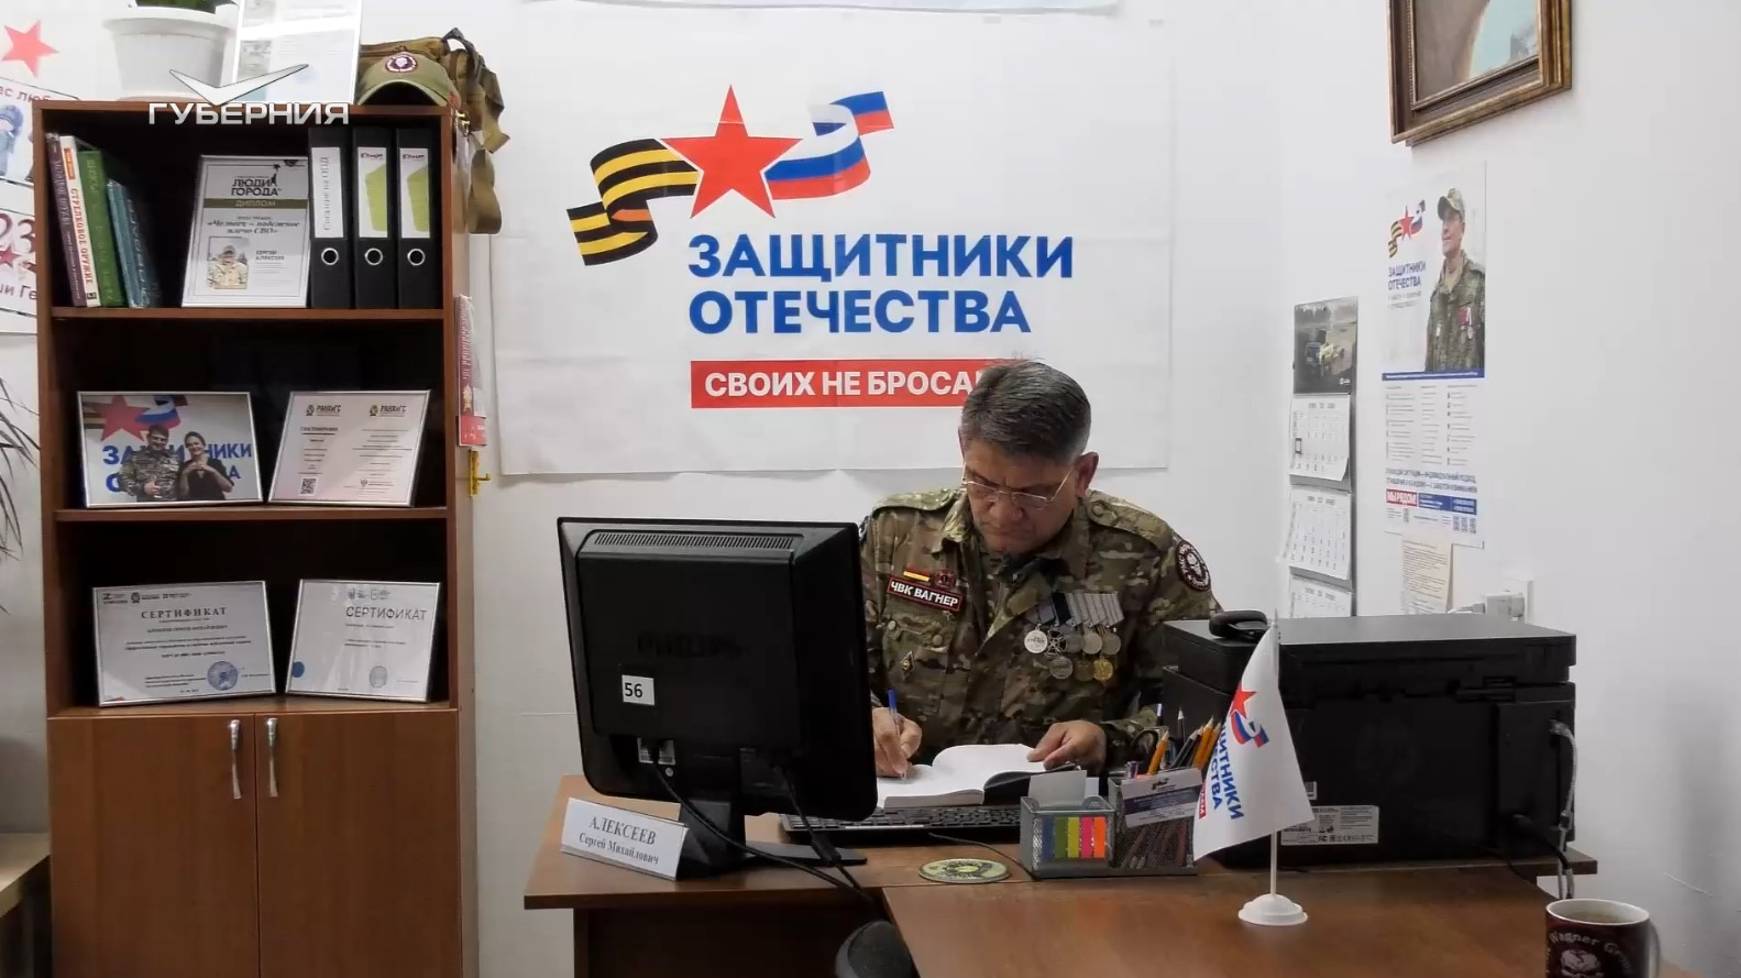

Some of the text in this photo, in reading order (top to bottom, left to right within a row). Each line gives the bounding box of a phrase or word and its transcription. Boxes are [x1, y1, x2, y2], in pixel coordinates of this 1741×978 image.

[231, 187, 278, 197] ГОРОДА
[232, 178, 272, 188] ЛЮДИ
[688, 234, 1073, 282] ЗАЩИТНИКИ
[689, 290, 1031, 334] ОТЕЧЕСТВА
[704, 371, 816, 398] СВОИХ
[822, 371, 861, 396] НЕ
[891, 580, 959, 607] ЧВК ВАГНЕР
[141, 607, 227, 619] СЕРТИФИКАТ
[345, 606, 427, 621] СЕРТИФИКАТ
[624, 682, 644, 698] 56
[589, 816, 657, 846] АЛЕКСЕЕВ
[579, 832, 660, 865] Сергей Михайлович
